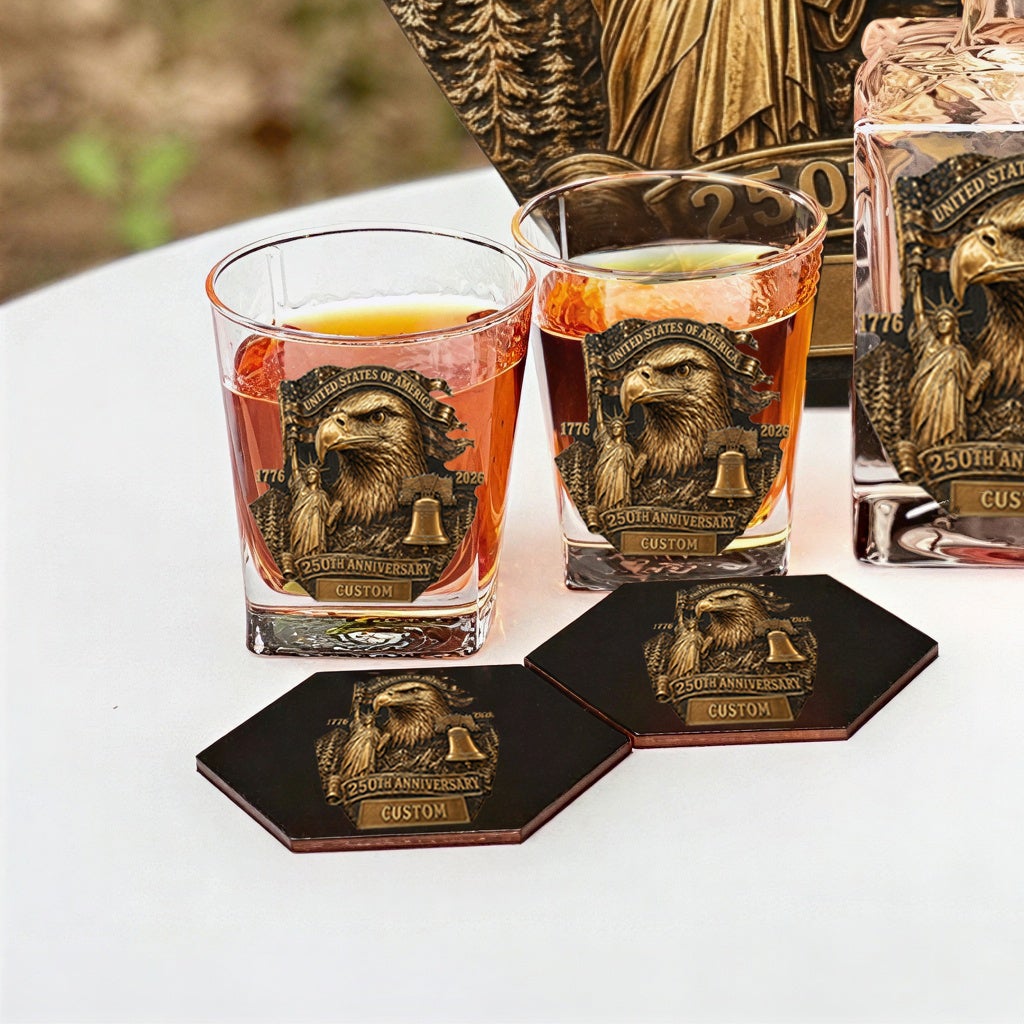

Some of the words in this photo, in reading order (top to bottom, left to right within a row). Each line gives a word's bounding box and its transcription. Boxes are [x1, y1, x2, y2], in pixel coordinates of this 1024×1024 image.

[931, 179, 985, 224] UNITED
[859, 313, 904, 334] 1776
[608, 335, 643, 364] UNITED
[643, 323, 683, 339] STATES
[685, 324, 700, 336] OF
[698, 328, 740, 364] AMERICA
[303, 381, 338, 411] UNITED
[339, 369, 378, 386] STATES
[380, 370, 395, 382] OF
[393, 375, 435, 413] AMERICA
[560, 422, 590, 436] 1776
[760, 424, 789, 438] 2026
[931, 449, 995, 475] 250TH
[256, 469, 285, 483] 1776
[456, 471, 484, 484] 2026
[606, 510, 649, 527] 250TH
[652, 511, 736, 528] ANNIVERSARY
[640, 538, 698, 551] CUSTOM
[302, 557, 345, 573] 250TH
[347, 558, 431, 575] ANNIVERSARY
[335, 585, 393, 598] CUSTOM
[676, 677, 717, 693] 250TH
[719, 677, 801, 691] ANNIVERSARY
[708, 703, 771, 718] CUSTOM
[349, 777, 391, 795] 250TH
[395, 777, 480, 792] ANNIVERSARY
[381, 803, 447, 821] CUSTOM
